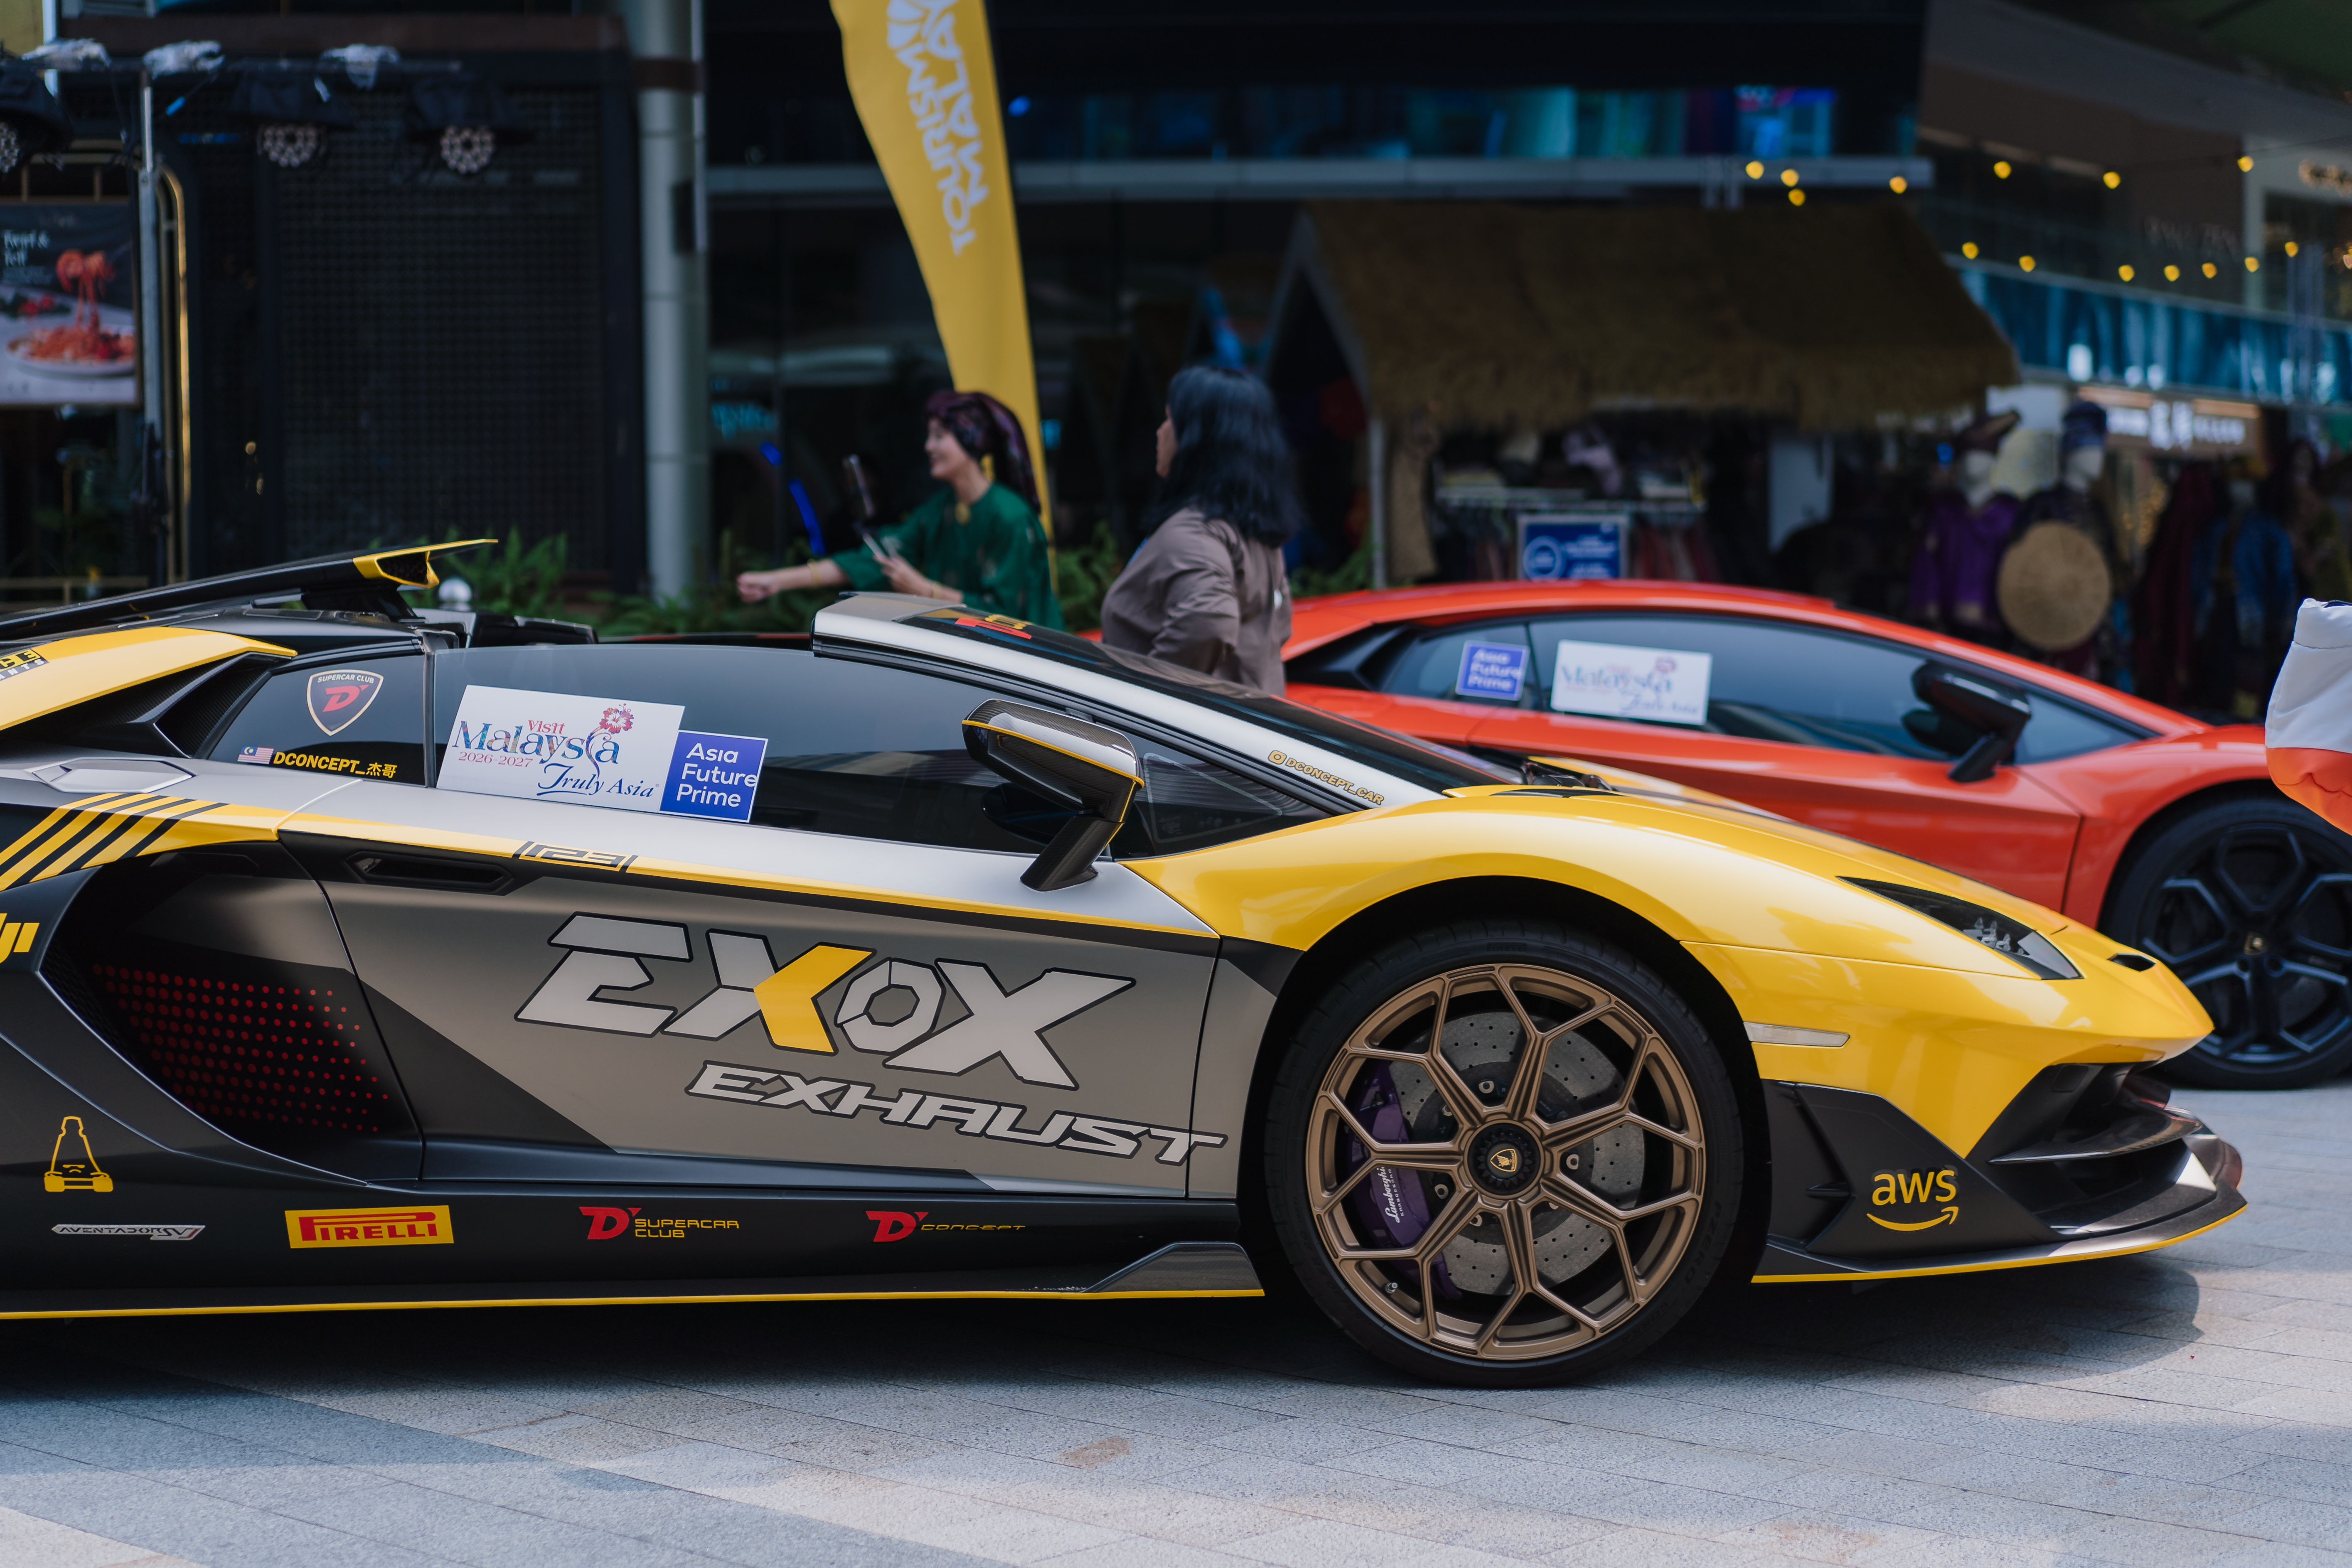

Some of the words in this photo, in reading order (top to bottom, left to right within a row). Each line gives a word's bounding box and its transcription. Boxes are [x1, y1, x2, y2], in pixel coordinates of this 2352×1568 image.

[888, 41, 977, 256] TOURISM
[317, 674, 355, 683] SUPERCAR
[356, 674, 374, 684] CLUB
[528, 720, 565, 735] Visit
[451, 720, 620, 764] Malaysia
[685, 742, 738, 763] Asia
[458, 751, 534, 767] 2026-2027
[536, 762, 605, 796] Truly
[681, 763, 759, 787] Future
[1285, 756, 1385, 806] DCONCEPT_CAR
[676, 783, 741, 808] Prime
[684, 1059, 1228, 1167] EXHAUST
[1376, 1166, 1401, 1224] Lamborghi
[1872, 1170, 1957, 1206] aws
[298, 1212, 438, 1241] PIRELLI
[635, 1218, 740, 1229] SUPERCAR
[635, 1229, 685, 1238] CLUB
